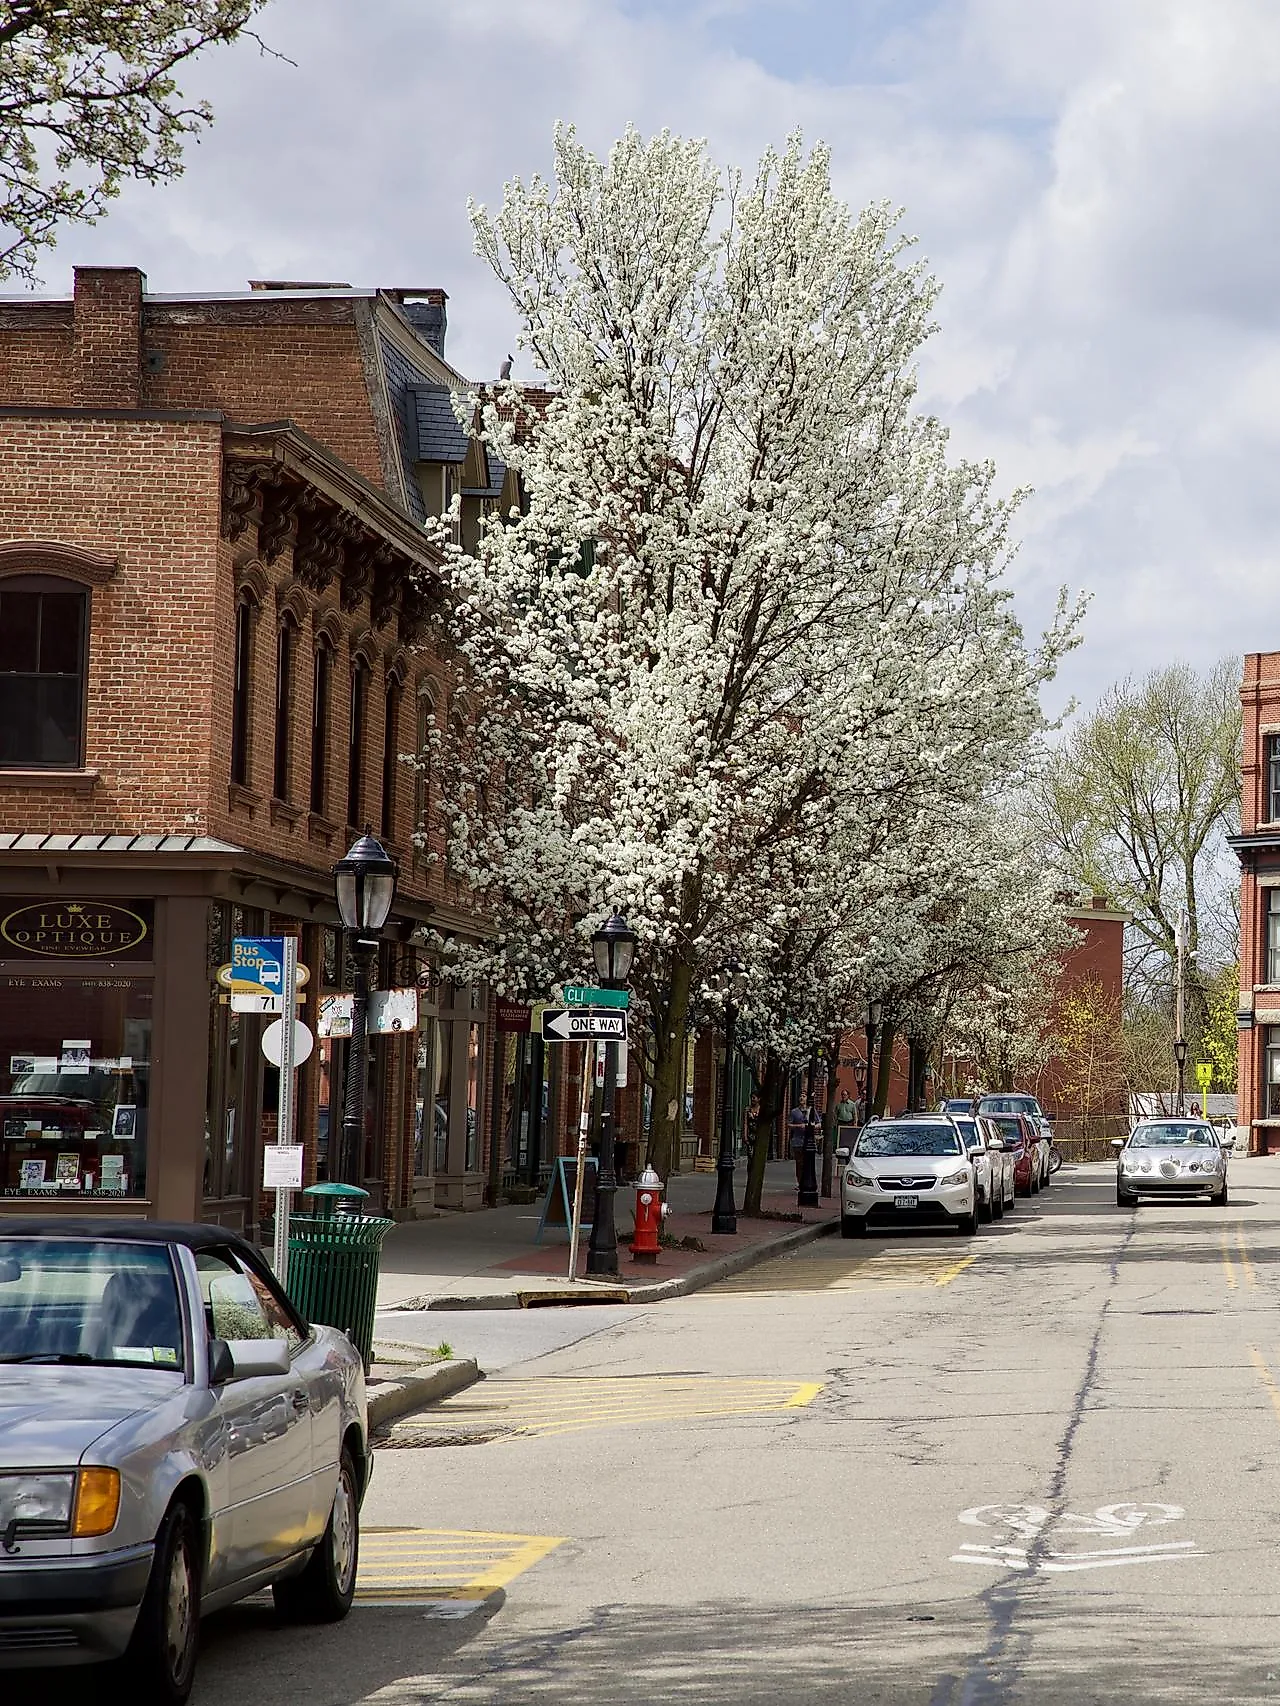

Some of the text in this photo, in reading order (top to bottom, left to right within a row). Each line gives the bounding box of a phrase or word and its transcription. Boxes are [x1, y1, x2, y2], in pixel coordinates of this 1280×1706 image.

[40, 914, 112, 928] LUXE
[16, 931, 132, 945] OPTIQUE
[234, 944, 259, 955] Bus
[233, 955, 265, 969] Stop
[8, 978, 26, 987] EYE
[31, 979, 63, 987] EXAMS
[260, 996, 275, 1010] 71
[571, 1018, 620, 1031] ONE WAY
[4, 1187, 21, 1196] EYE
[27, 1187, 58, 1197] EXAMS
